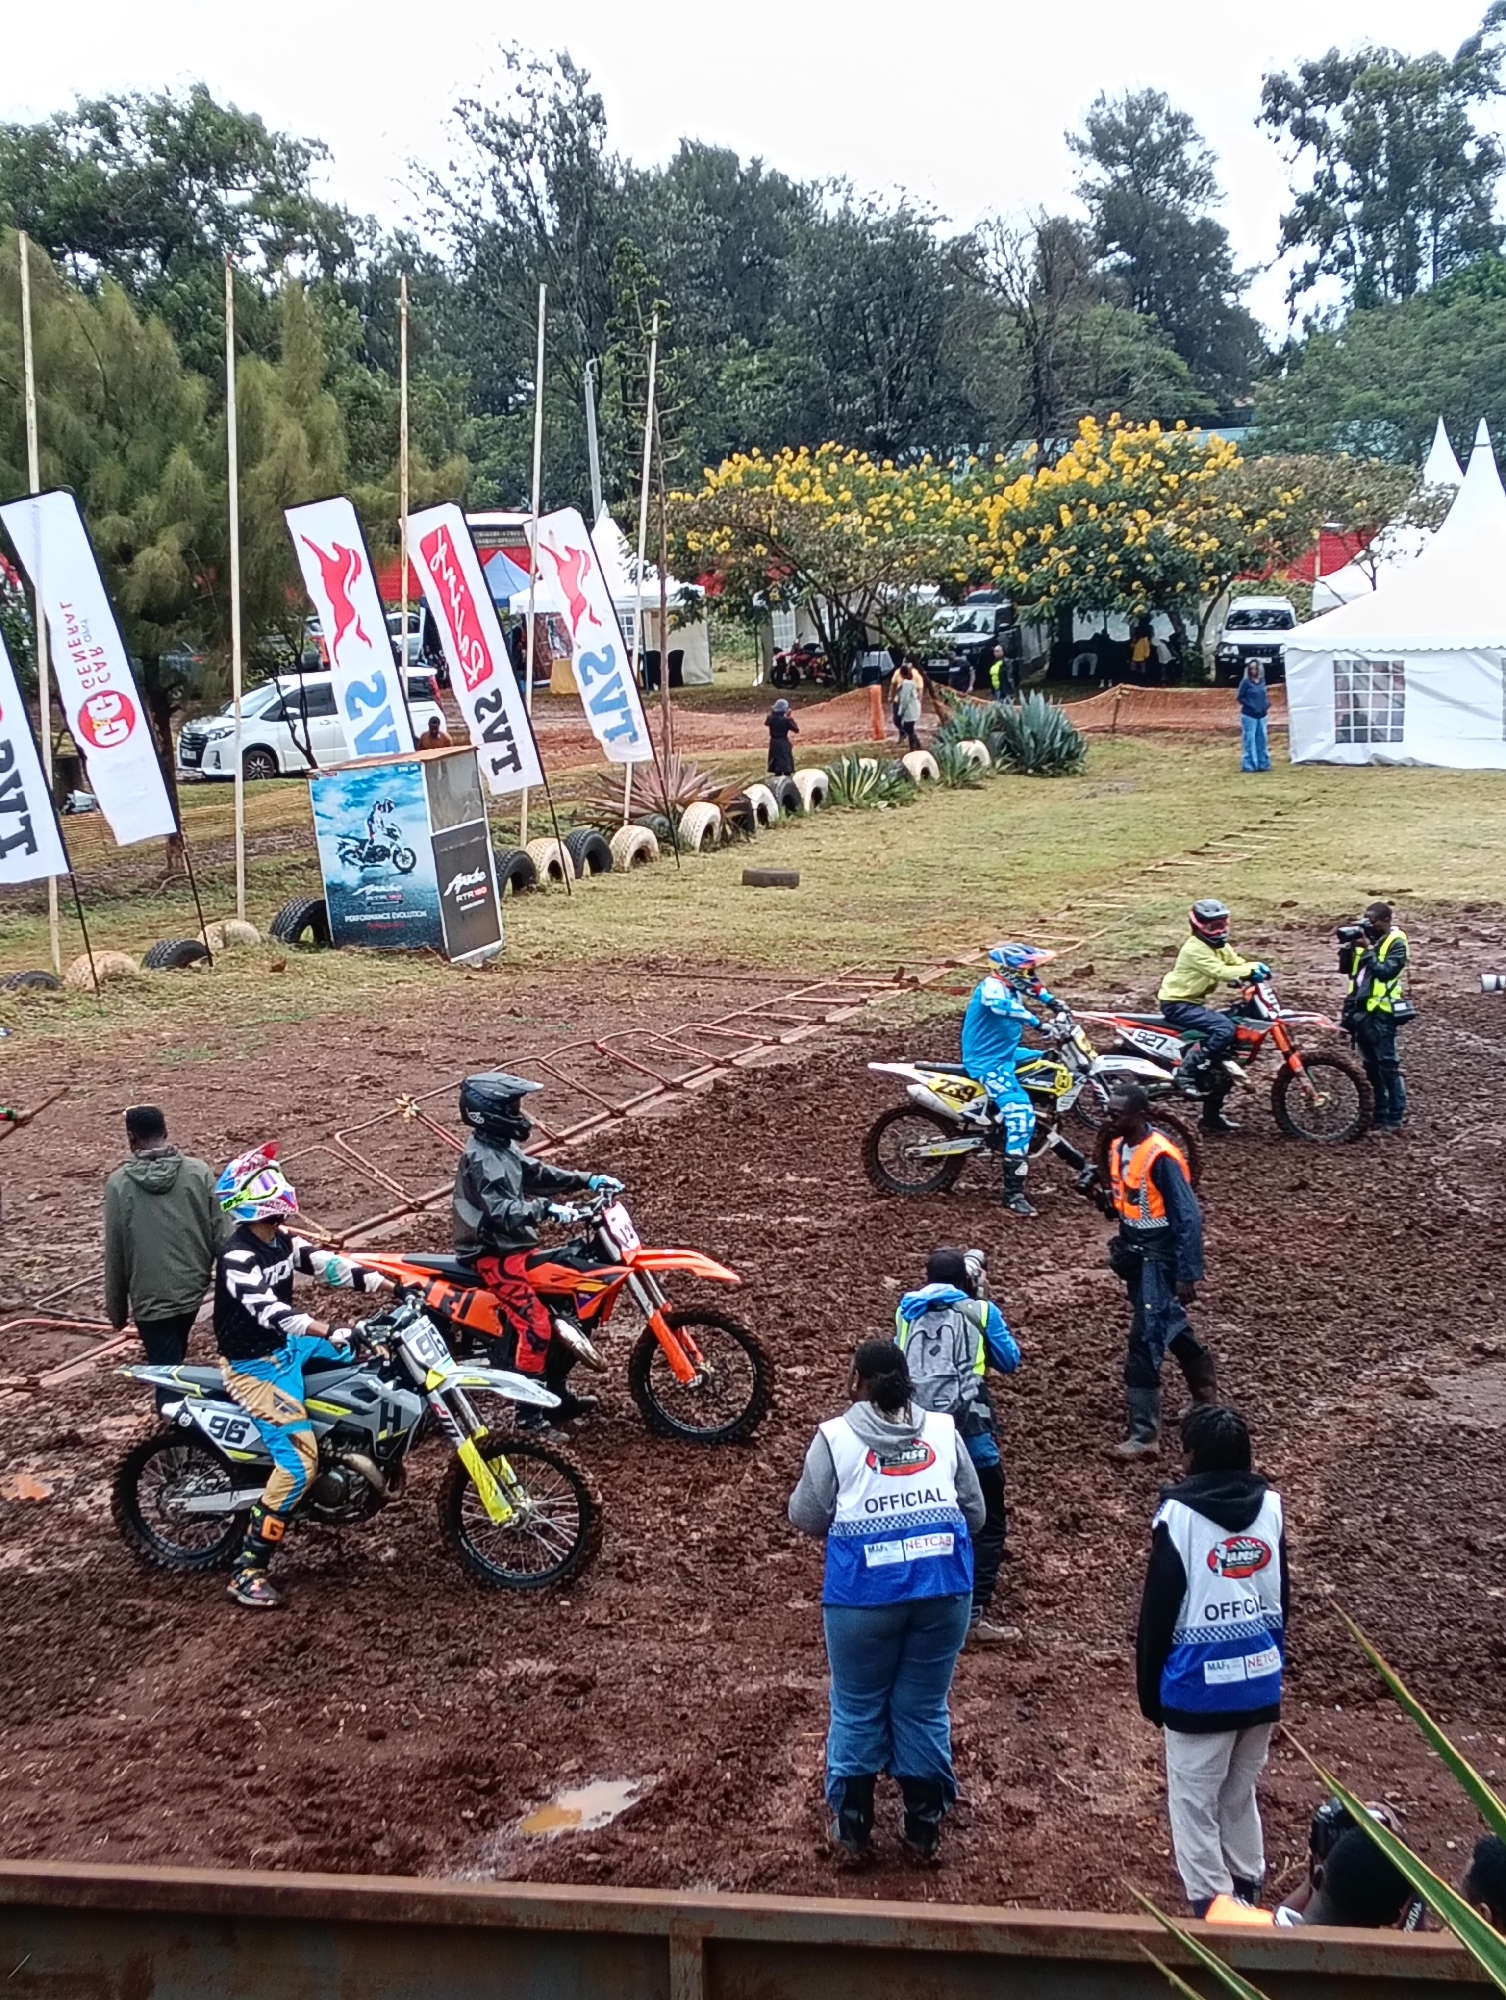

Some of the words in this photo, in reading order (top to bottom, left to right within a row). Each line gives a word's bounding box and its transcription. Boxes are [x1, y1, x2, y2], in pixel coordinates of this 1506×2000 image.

[1134, 1031, 1168, 1050] 927
[208, 1415, 250, 1444] 96
[864, 1487, 948, 1513] OFFICIAL
[905, 1535, 952, 1551] NETCAB
